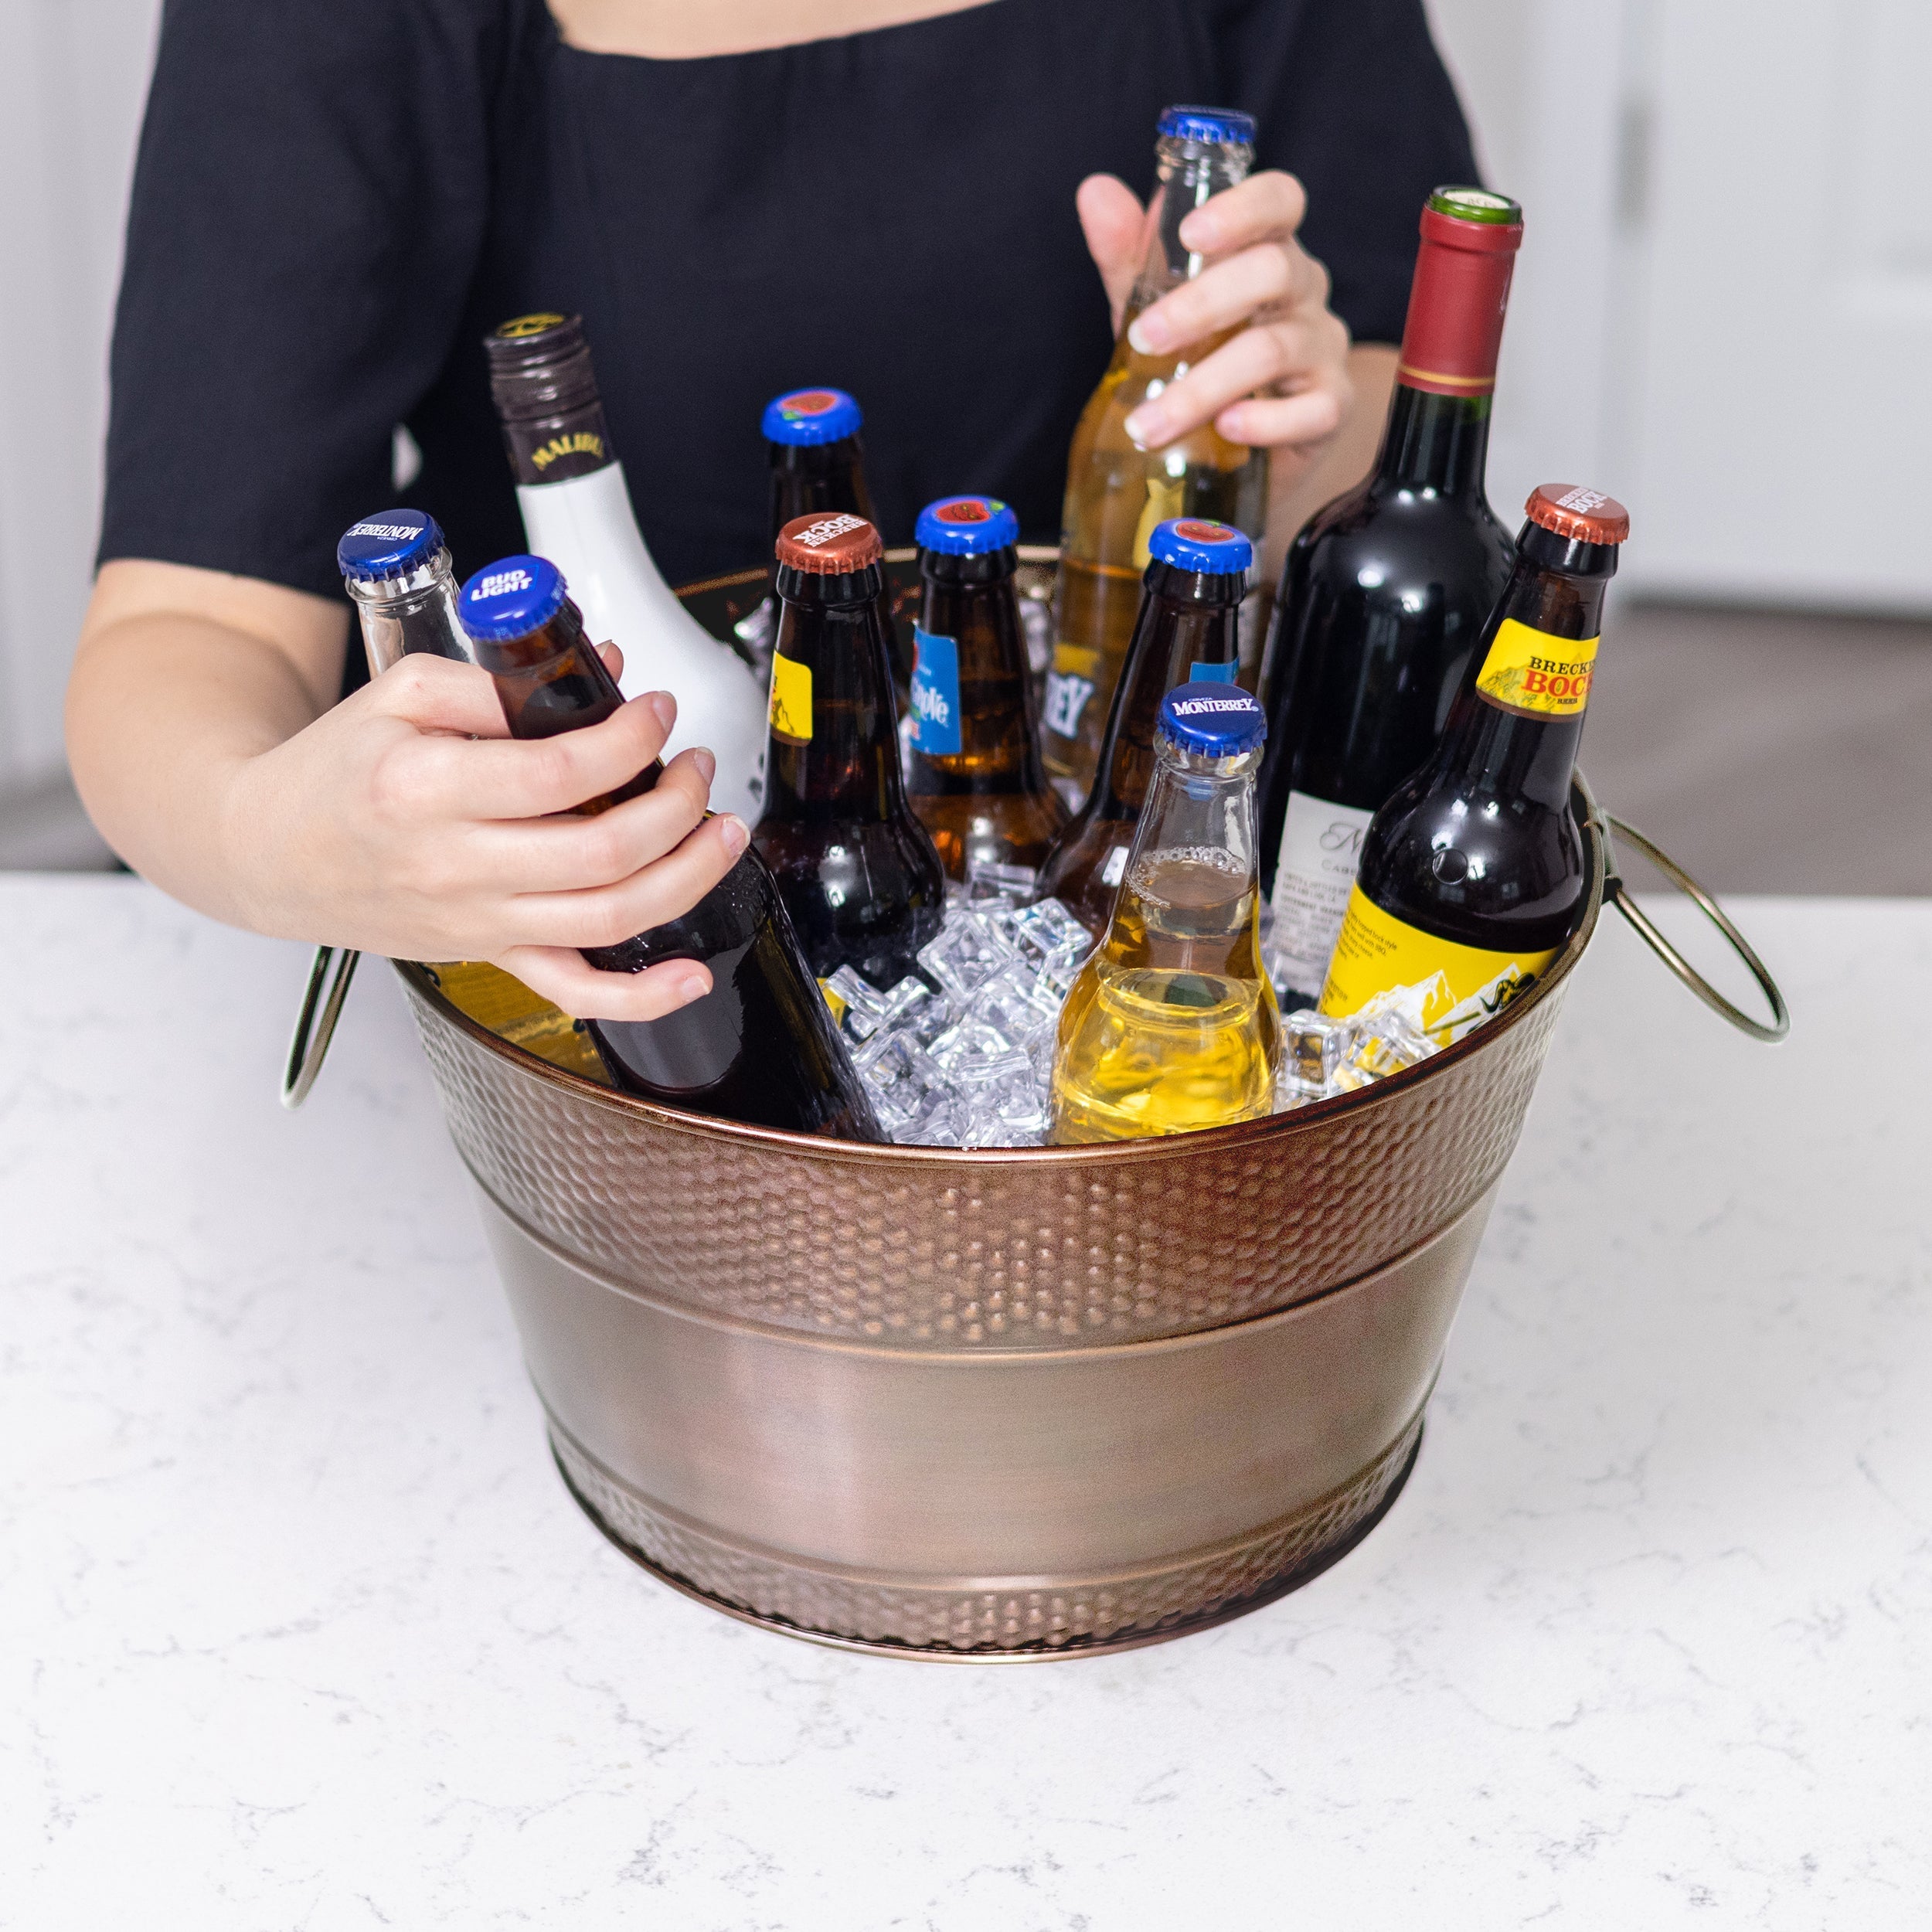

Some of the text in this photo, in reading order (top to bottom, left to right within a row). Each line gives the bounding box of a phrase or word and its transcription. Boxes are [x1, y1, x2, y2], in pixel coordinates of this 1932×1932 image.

[1566, 491, 1607, 514] BOCK
[347, 524, 423, 540] MONTERREY
[792, 514, 859, 544] BOCK
[808, 519, 868, 547] BRECKEN
[471, 577, 533, 601] LIGHT
[481, 570, 526, 590] BUD
[1172, 699, 1253, 716] MONTERREY
[1385, 938, 1397, 951] style
